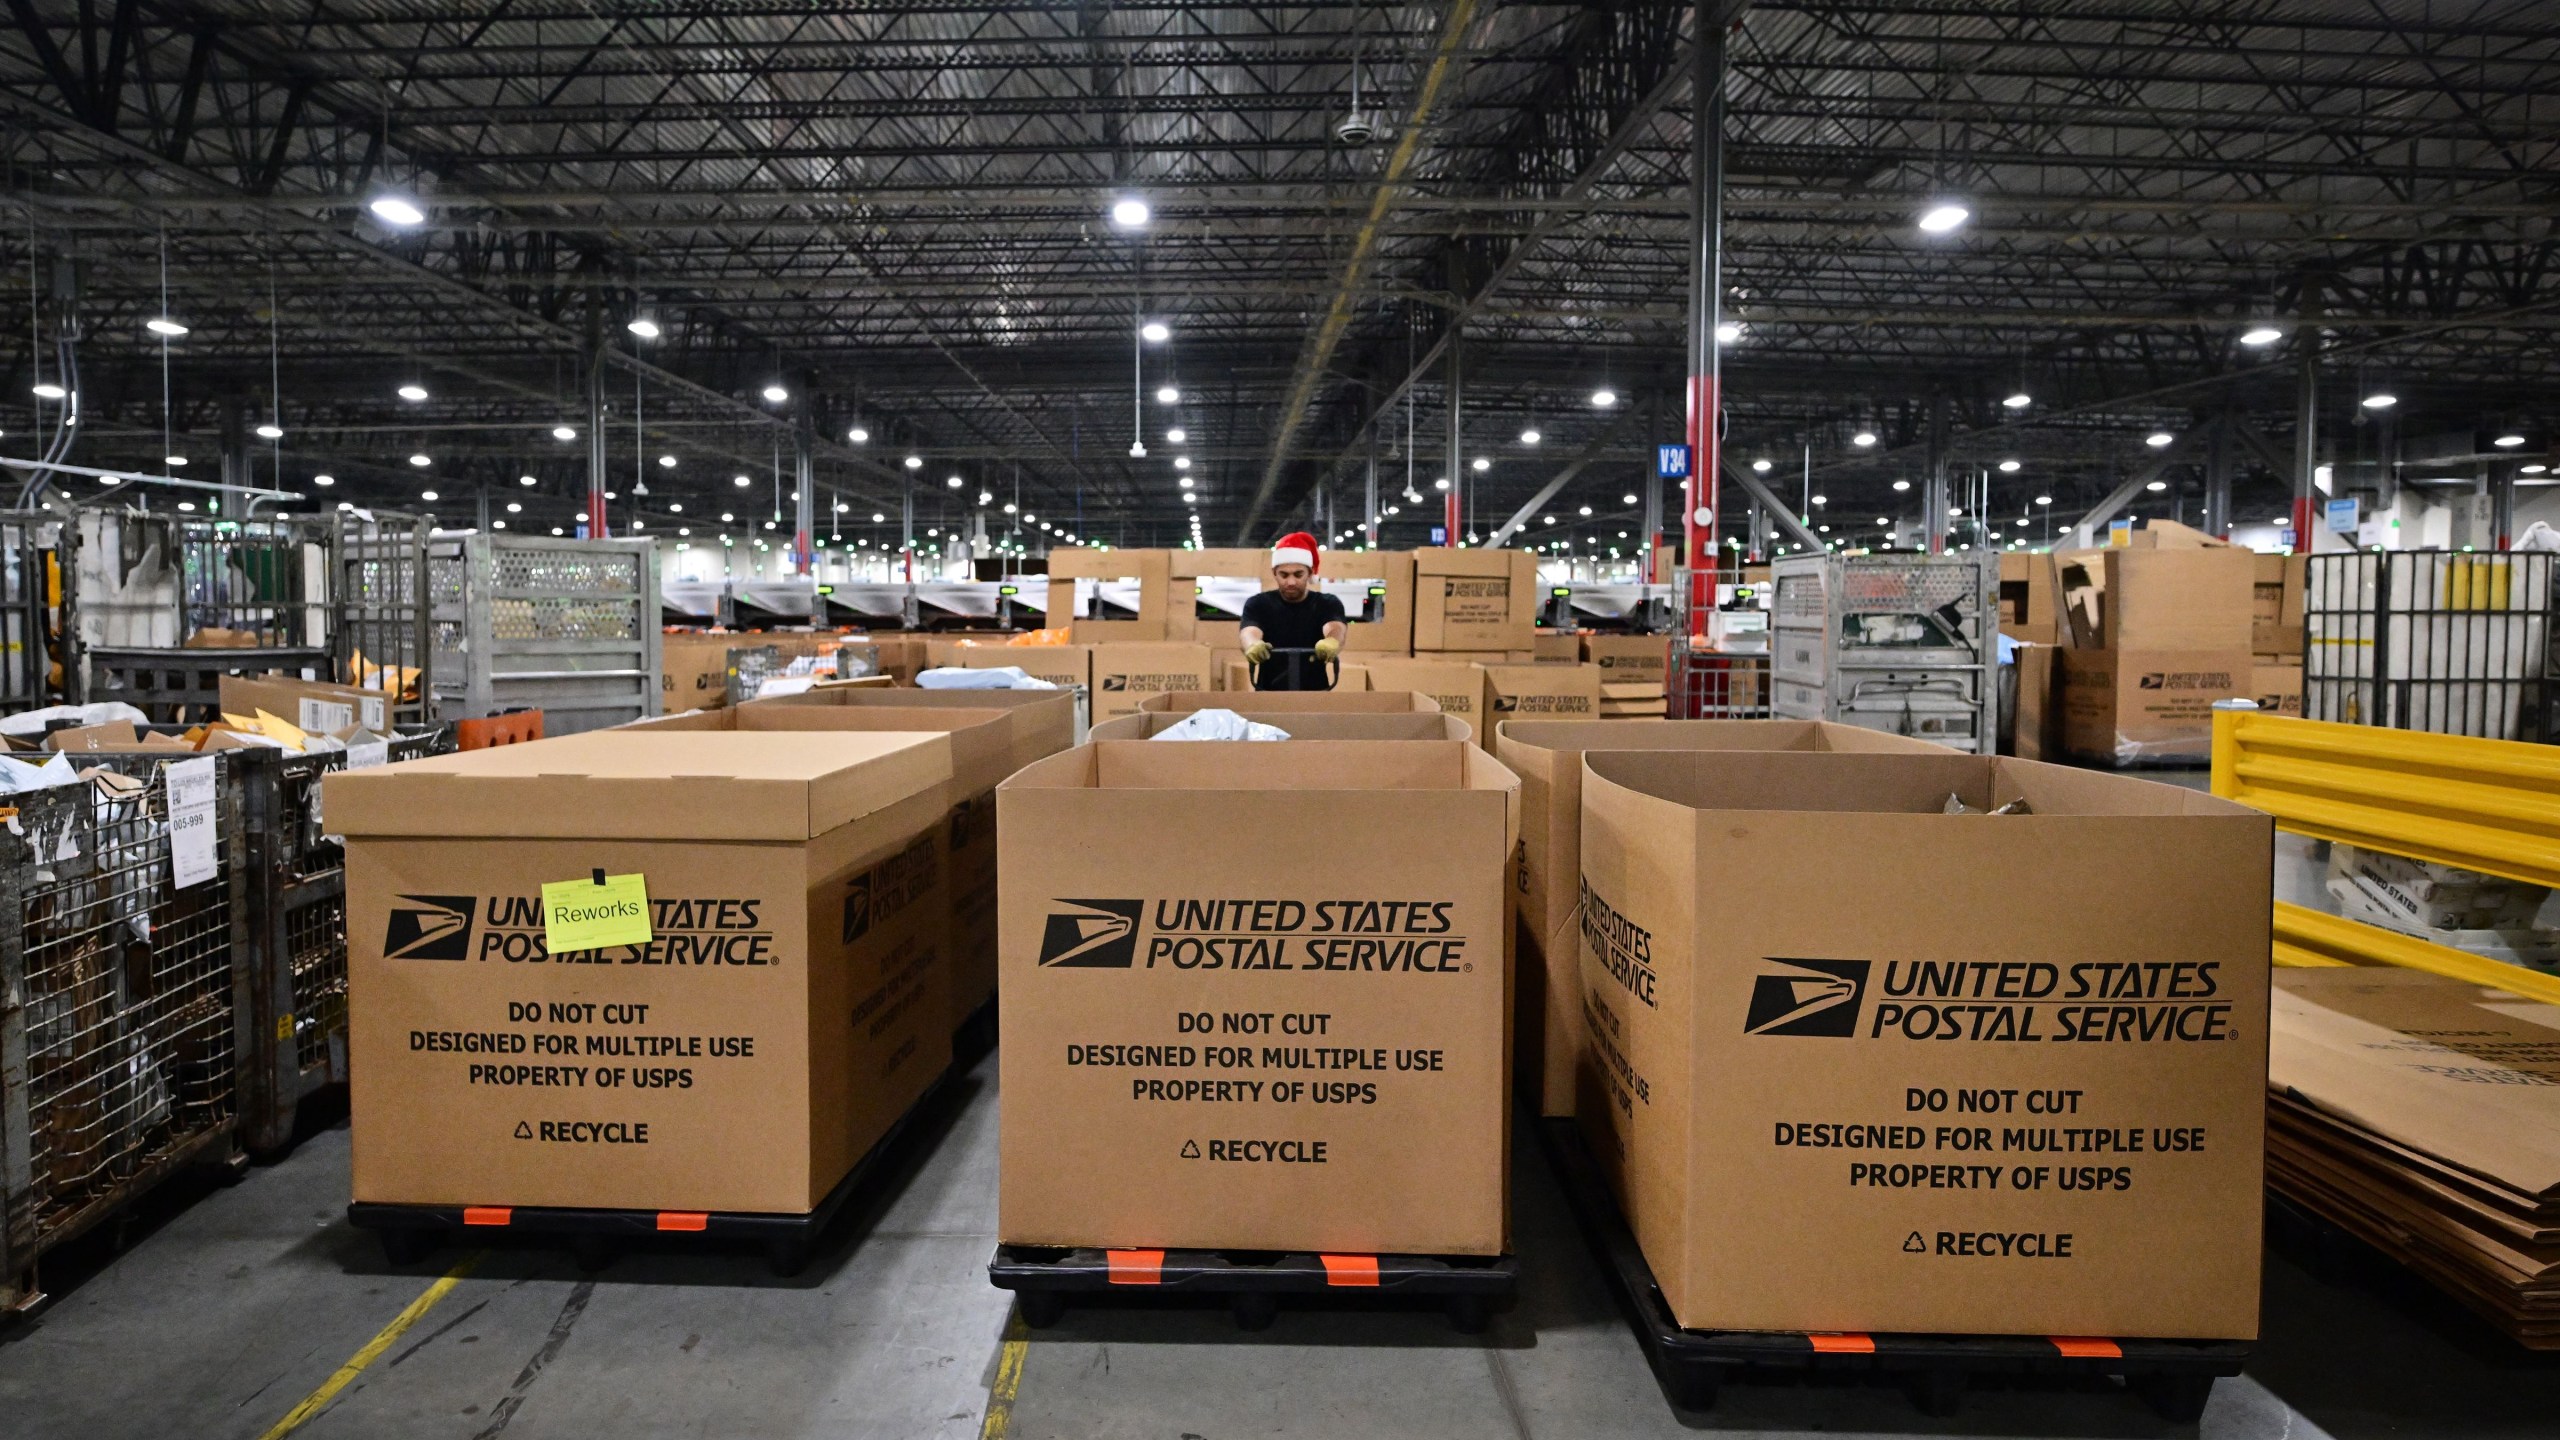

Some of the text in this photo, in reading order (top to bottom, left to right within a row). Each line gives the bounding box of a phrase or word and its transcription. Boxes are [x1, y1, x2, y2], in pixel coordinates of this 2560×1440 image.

[1660, 448, 1686, 473] V34
[1128, 683, 1160, 692] POSTAL
[1129, 674, 1199, 683] UNITED STATES
[1440, 703, 1472, 712] ERVICE
[1518, 703, 1591, 713] POSTAL SERVICE
[1519, 695, 1588, 704] UNITED STATES
[173, 813, 204, 831] 005-999
[554, 900, 639, 924] Reworks
[2388, 885, 2418, 914] STATES
[650, 899, 760, 929] TATES
[1155, 899, 1454, 934] UNITED STATES
[1612, 910, 1652, 964] STATES
[1146, 937, 1466, 973] POSTAL SERVICE
[1611, 946, 1656, 1008] SERVICE
[1883, 960, 2220, 999] UNITED STATES
[509, 1002, 649, 1025] DO NOT CUT
[1179, 1013, 1332, 1035] DO NOT CUT
[1610, 1011, 1620, 1040] CUT
[1871, 1003, 2232, 1042] POSTAL SERVICE
[410, 1030, 754, 1058] DESIGNED FOR MULTIPLE USE
[1067, 1045, 1444, 1072] DESIGNED FOR MULTIPLE USE
[469, 1064, 693, 1089] PROPERTY OF USPS
[1635, 1073, 1650, 1106] USE
[1133, 1079, 1377, 1105] PROPERTY OF USPS
[1906, 1087, 2084, 1115] DO NOT CUT
[540, 1120, 649, 1144] RECYCLE
[1774, 1122, 2206, 1154] DESIGNED FOR MULTIPLE USE
[1209, 1139, 1328, 1163] RECYCLE
[1850, 1162, 2132, 1192] PROPERTY OF USPS
[1935, 1231, 2074, 1258] RECYCLE
